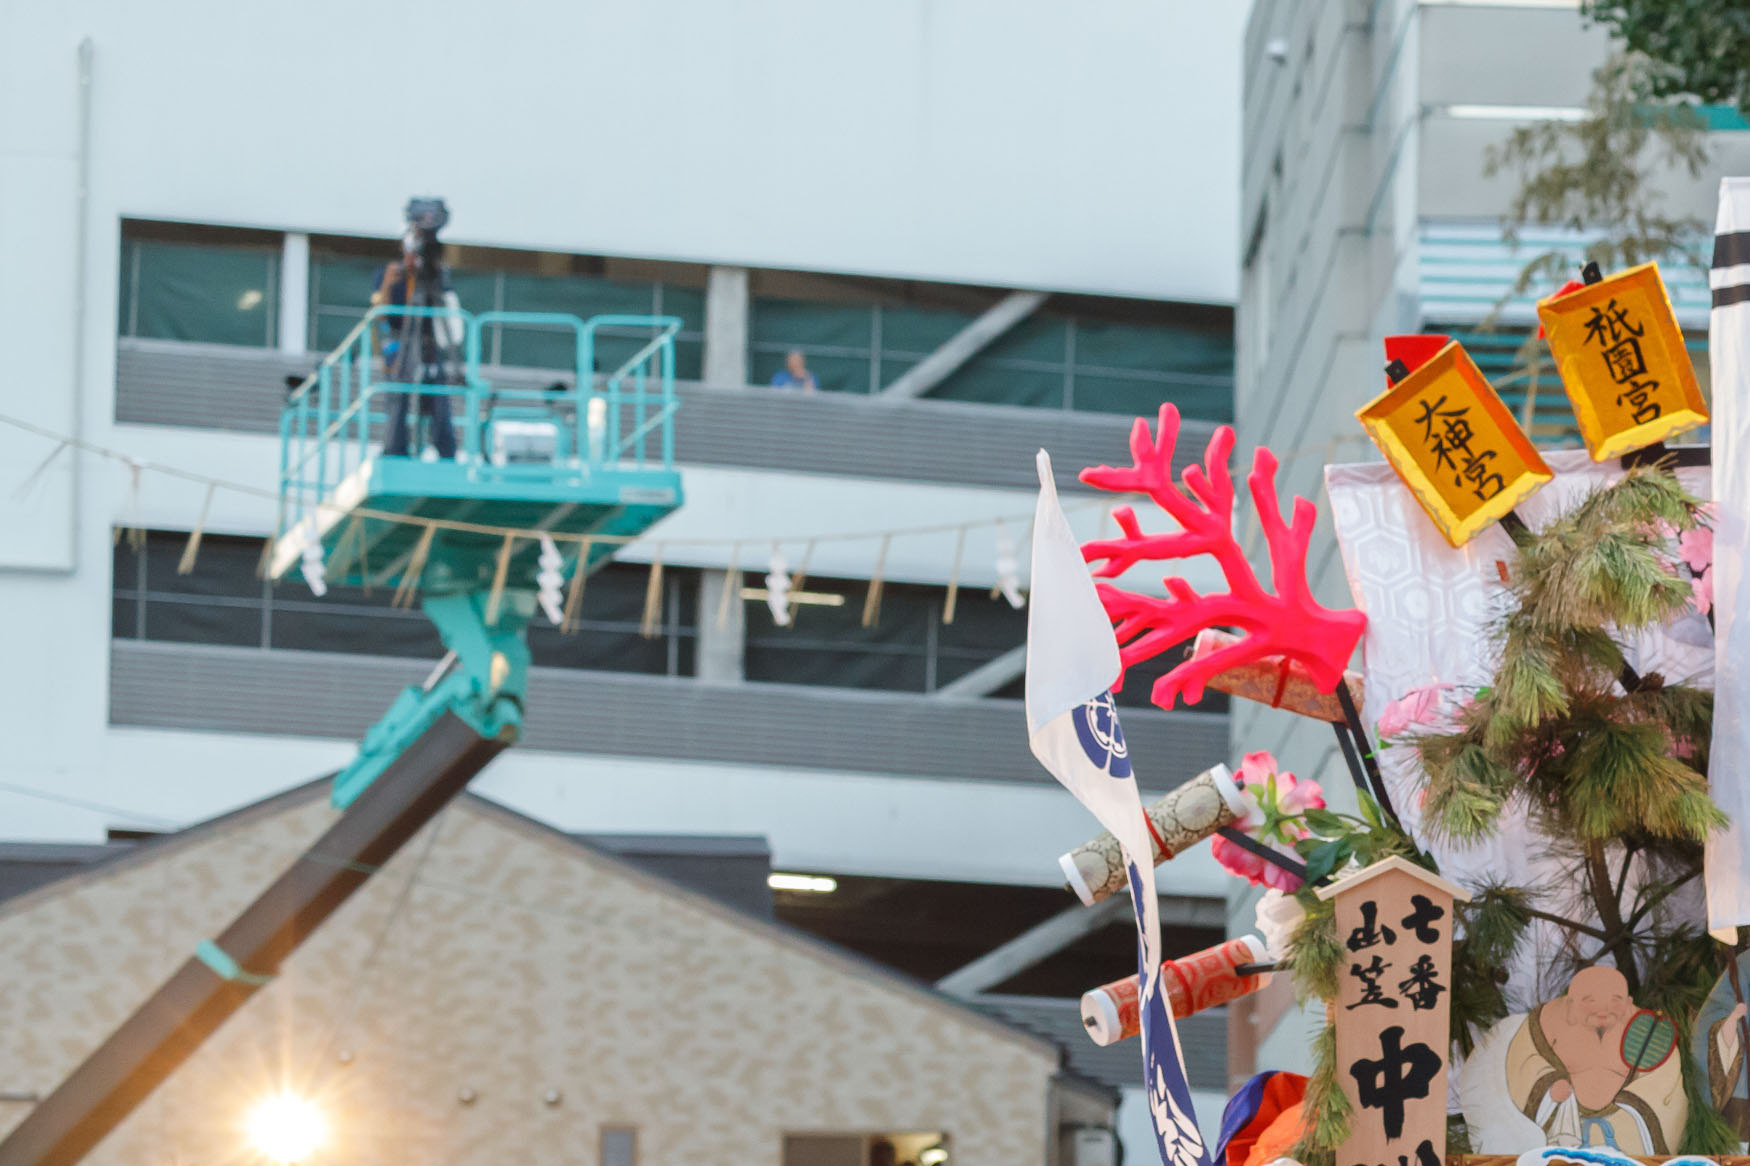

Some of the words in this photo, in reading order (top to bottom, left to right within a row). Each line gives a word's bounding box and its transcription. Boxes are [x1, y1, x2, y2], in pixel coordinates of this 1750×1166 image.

[1583, 298, 1662, 425] 祇園宮
[1413, 395, 1506, 501] 大神宮
[1346, 900, 1399, 1011] 山笠
[1400, 895, 1448, 1011] 七番
